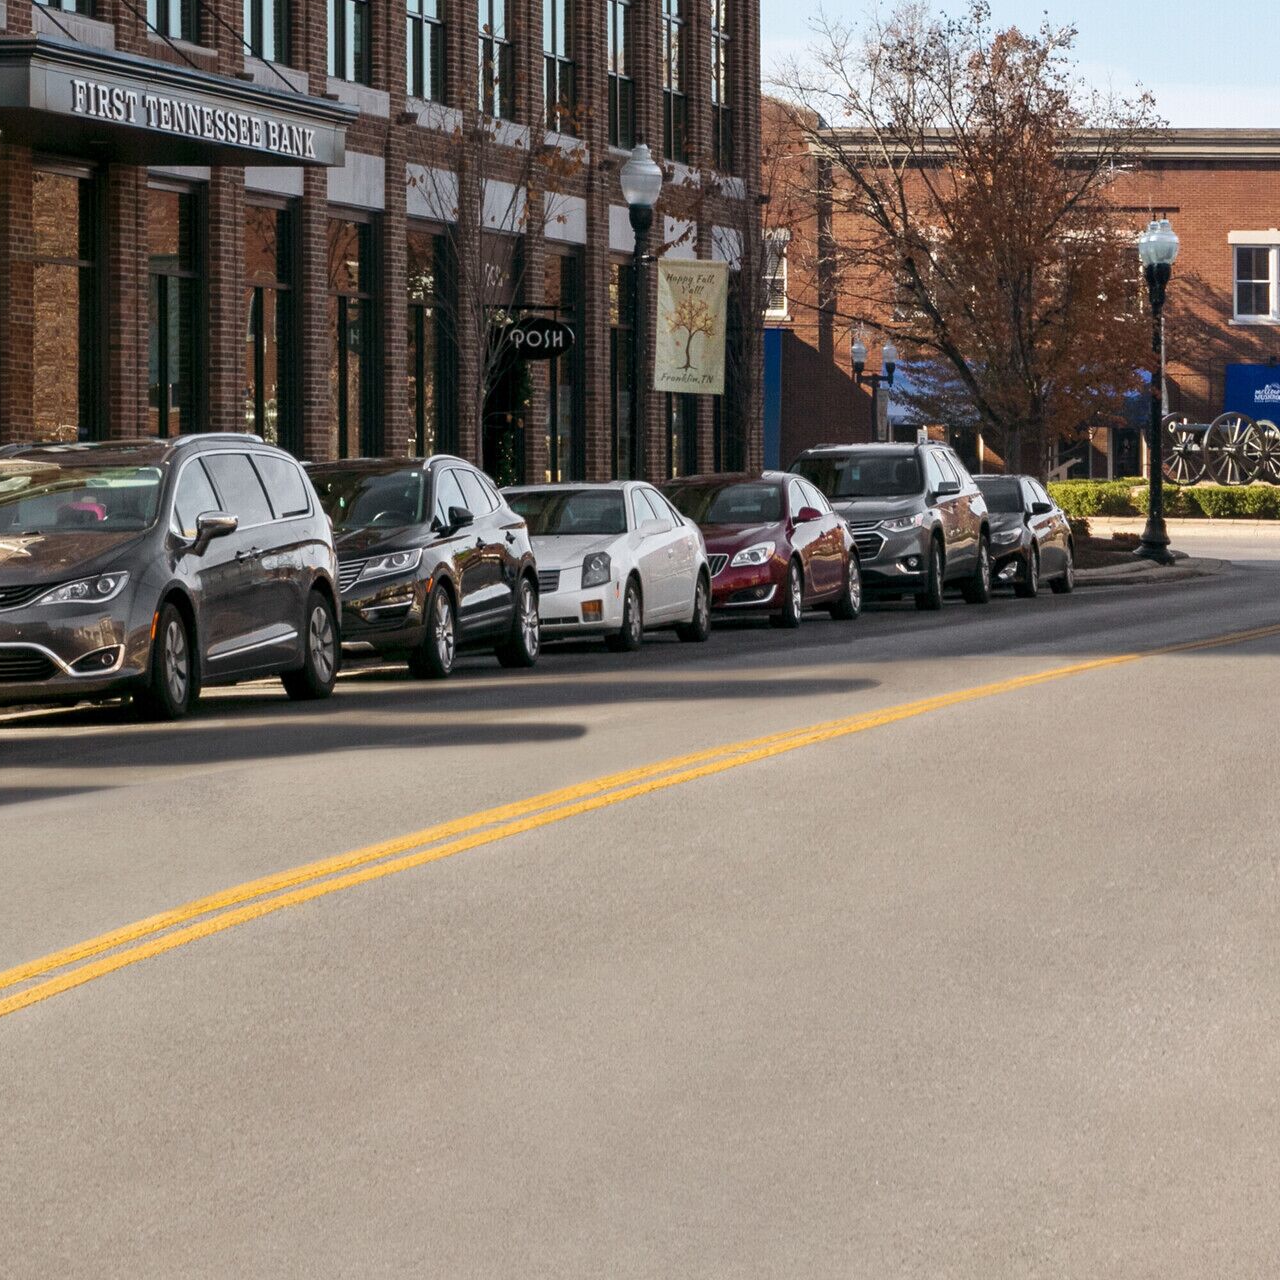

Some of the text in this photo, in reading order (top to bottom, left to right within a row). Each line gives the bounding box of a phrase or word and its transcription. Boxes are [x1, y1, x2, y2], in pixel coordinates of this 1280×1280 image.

[72, 79, 316, 159] FIRST TENNESSEE BANK
[510, 329, 563, 349] POSH
